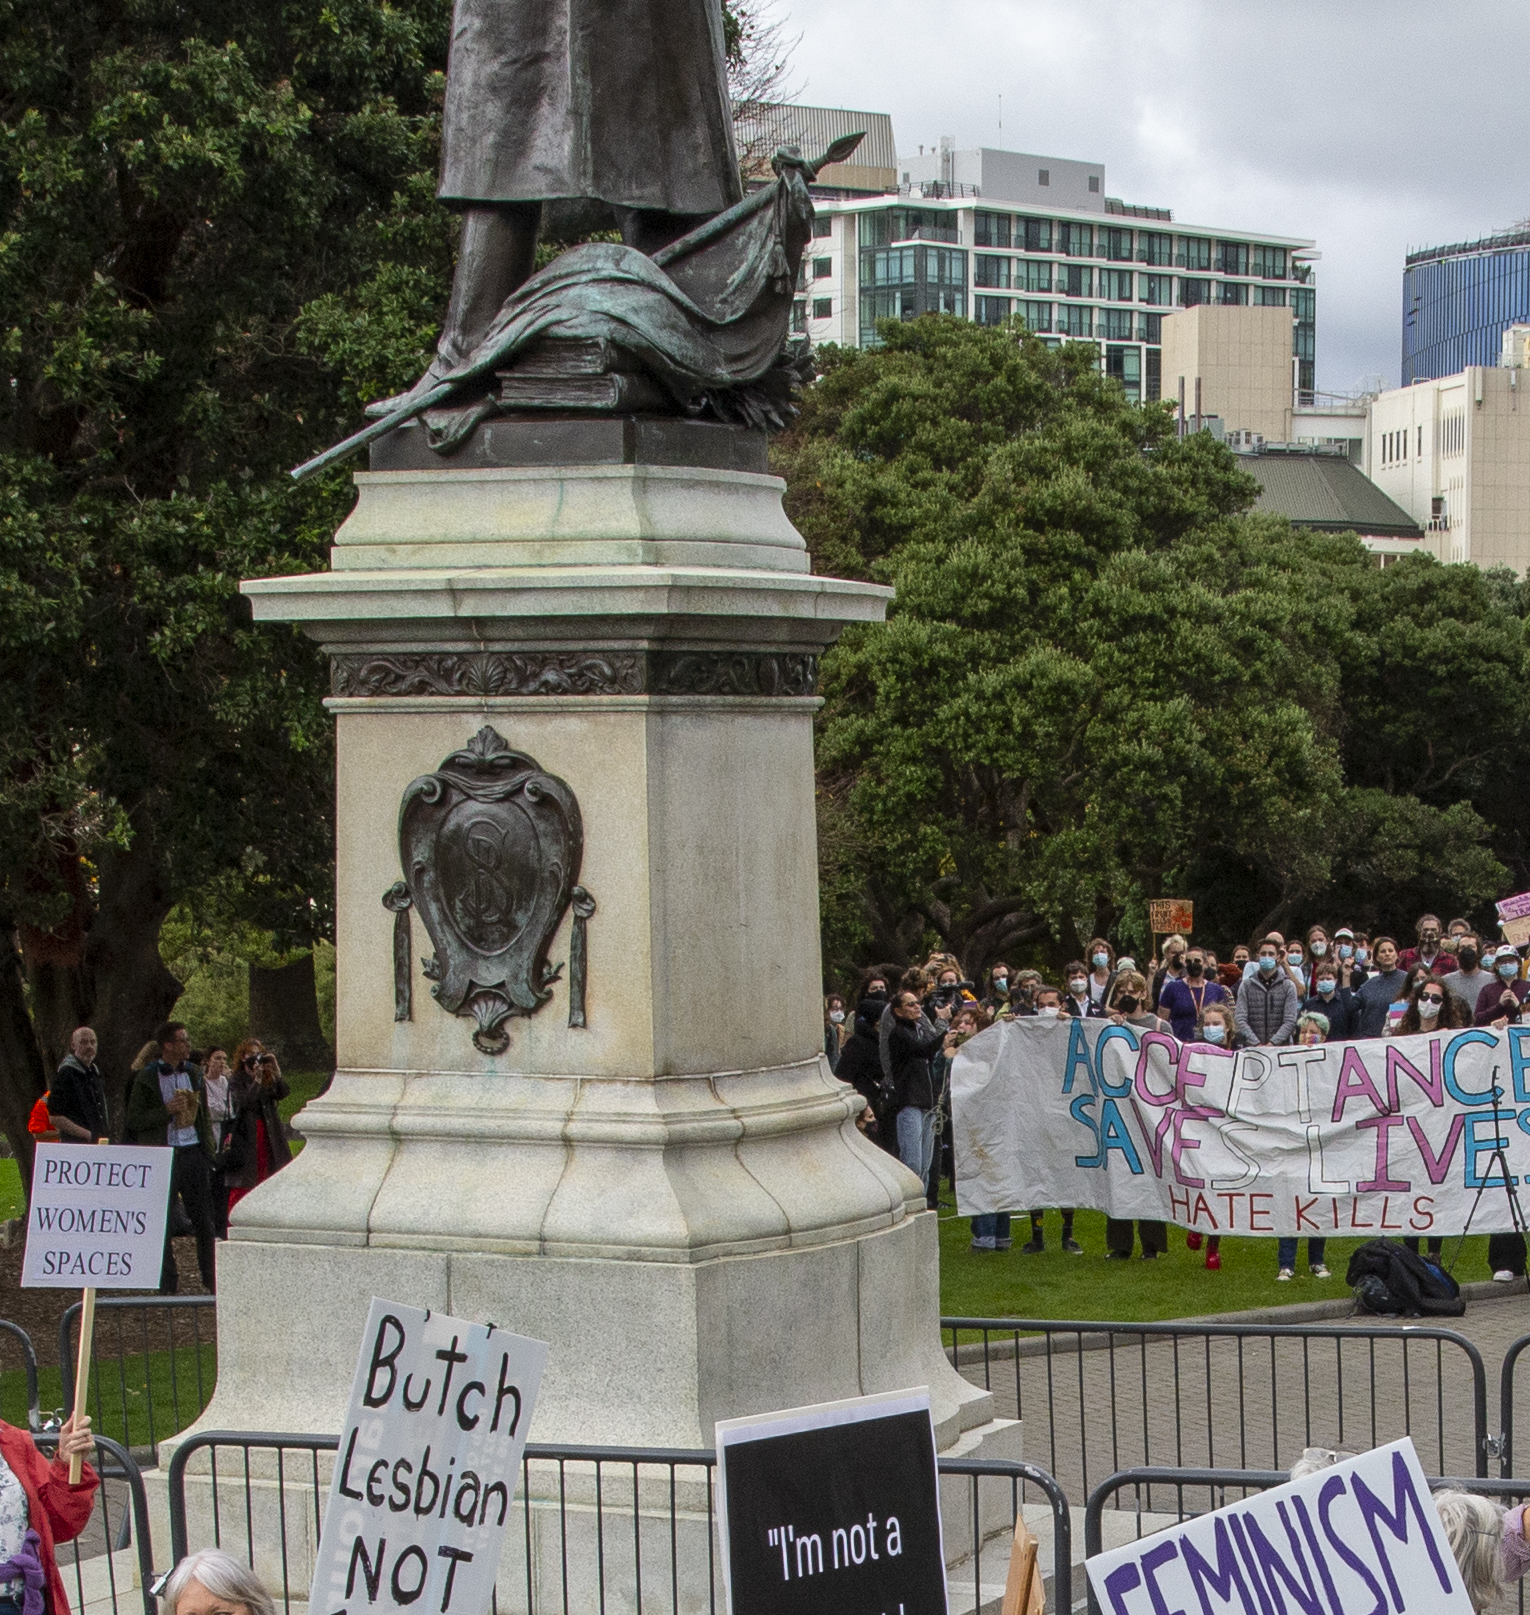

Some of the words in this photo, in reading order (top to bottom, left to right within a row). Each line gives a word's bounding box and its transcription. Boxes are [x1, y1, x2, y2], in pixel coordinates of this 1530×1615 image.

[1069, 1094, 1261, 1191] SAVES
[43, 1158, 152, 1190] PROTECT
[35, 1206, 148, 1236] WOMEN'S
[1168, 1186, 1274, 1232] HATE
[1296, 1195, 1435, 1232] KILLS
[42, 1250, 134, 1278] SPACES
[362, 1313, 522, 1440] Butch
[338, 1426, 509, 1527] Lesbian
[832, 1511, 879, 1566] not
[886, 1516, 903, 1556] a
[345, 1534, 474, 1614] NOT
